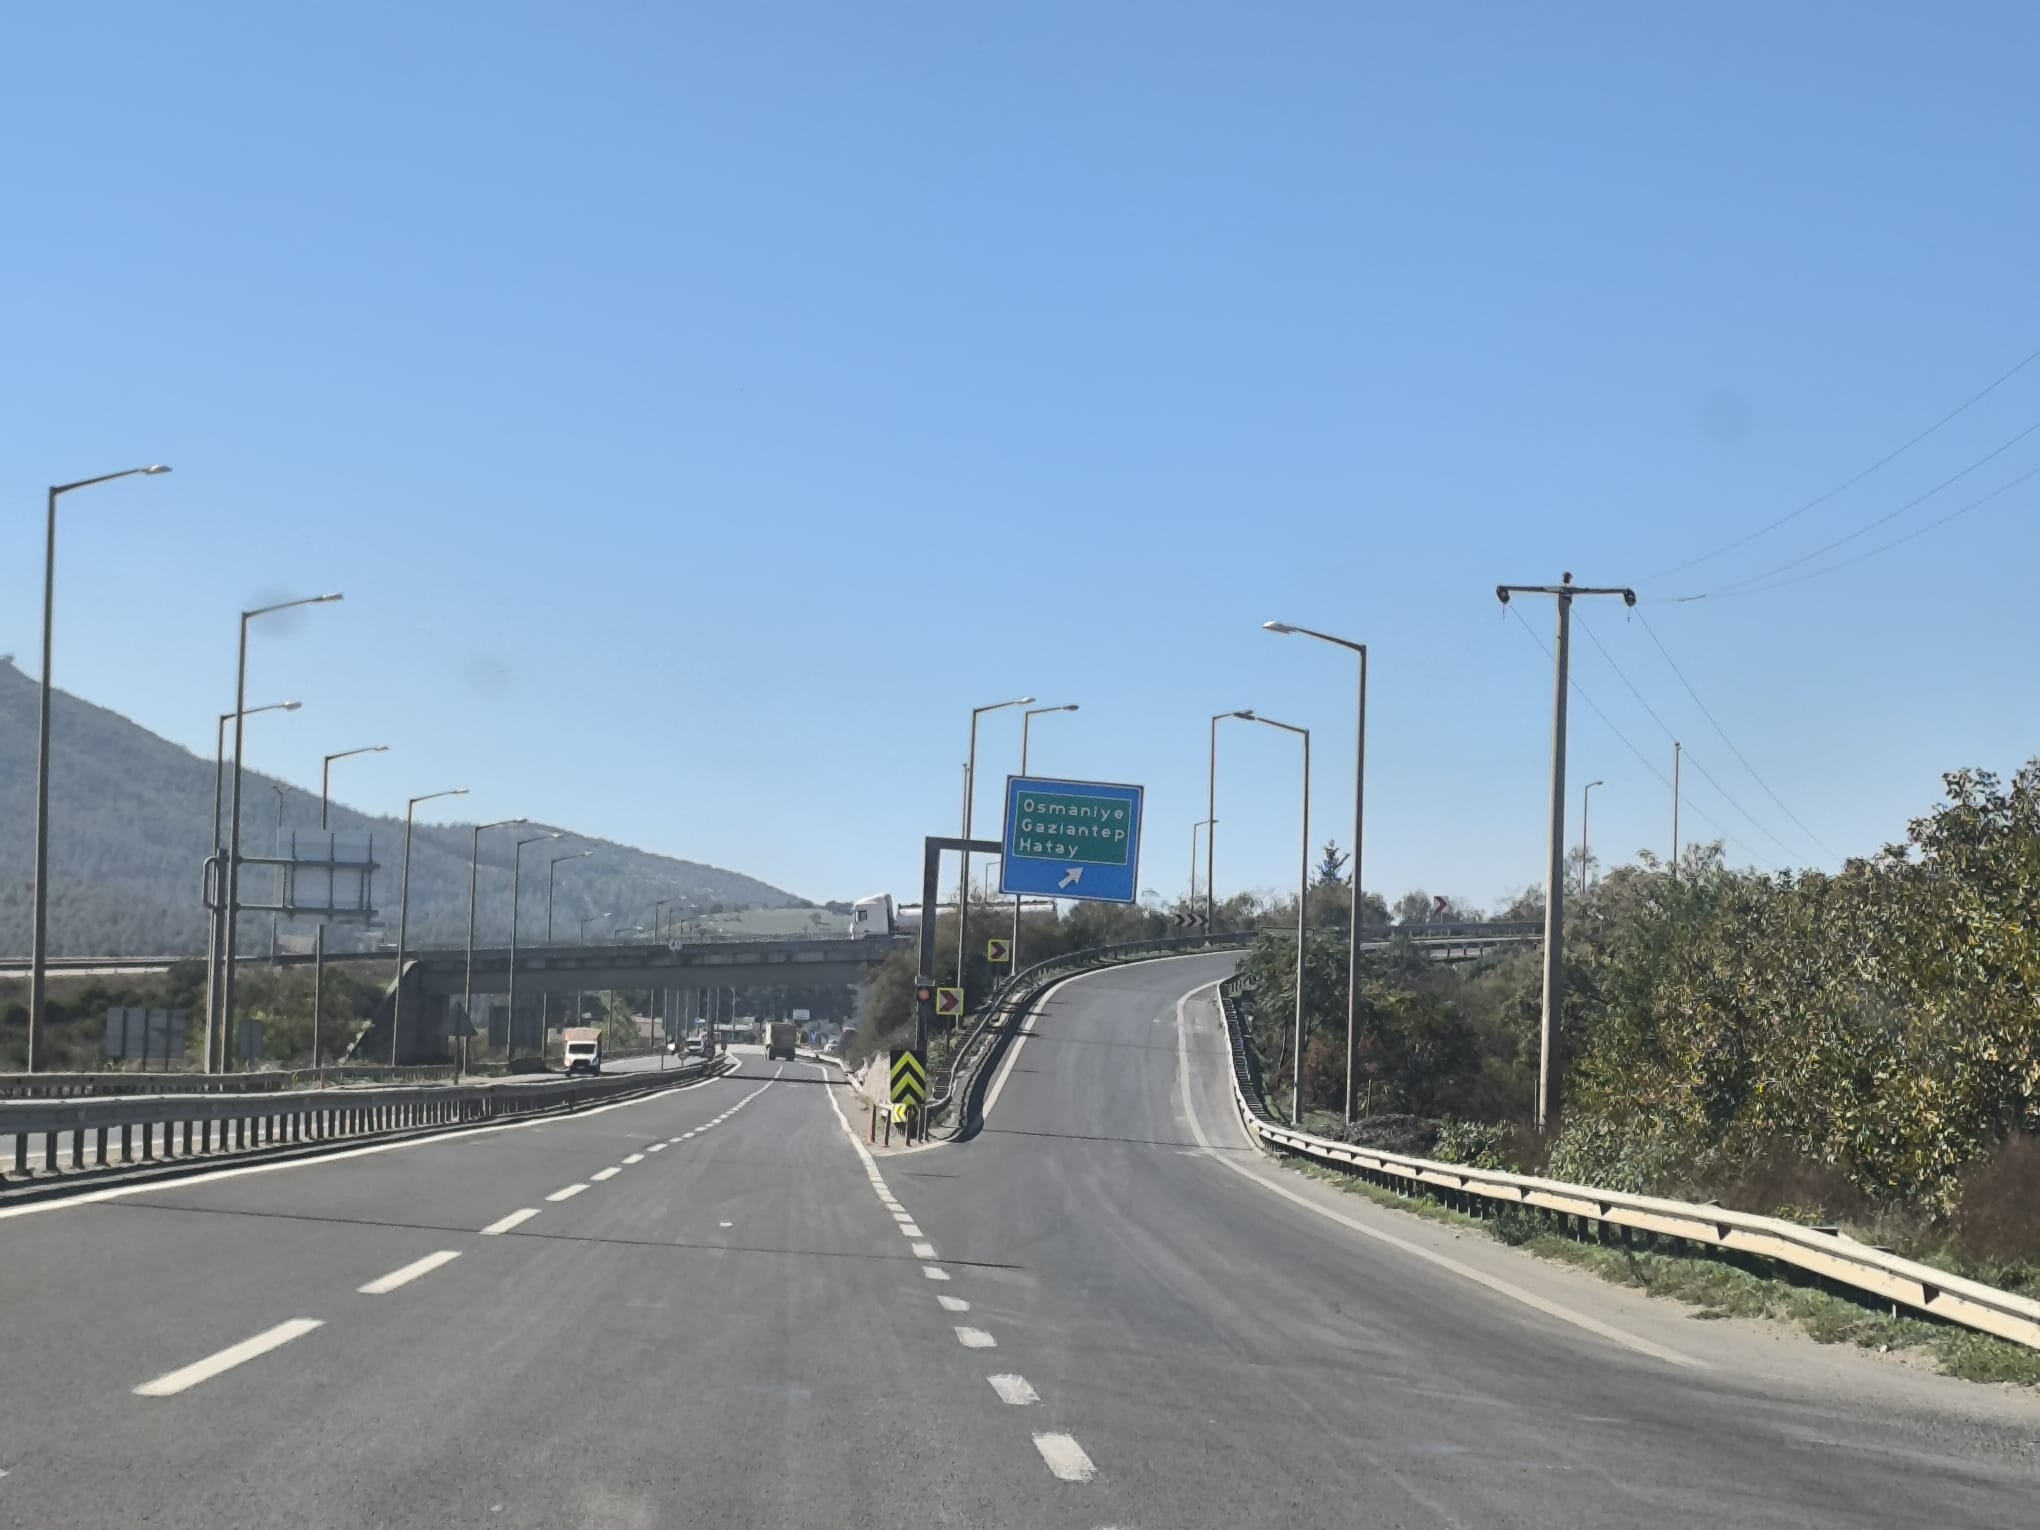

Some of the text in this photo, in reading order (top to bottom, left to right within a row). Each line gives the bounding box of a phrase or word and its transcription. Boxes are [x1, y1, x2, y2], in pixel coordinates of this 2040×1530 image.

[1023, 799, 1124, 822] Osmaniye
[1021, 818, 1126, 843] Gaziantep
[1019, 837, 1079, 858] Hatay
